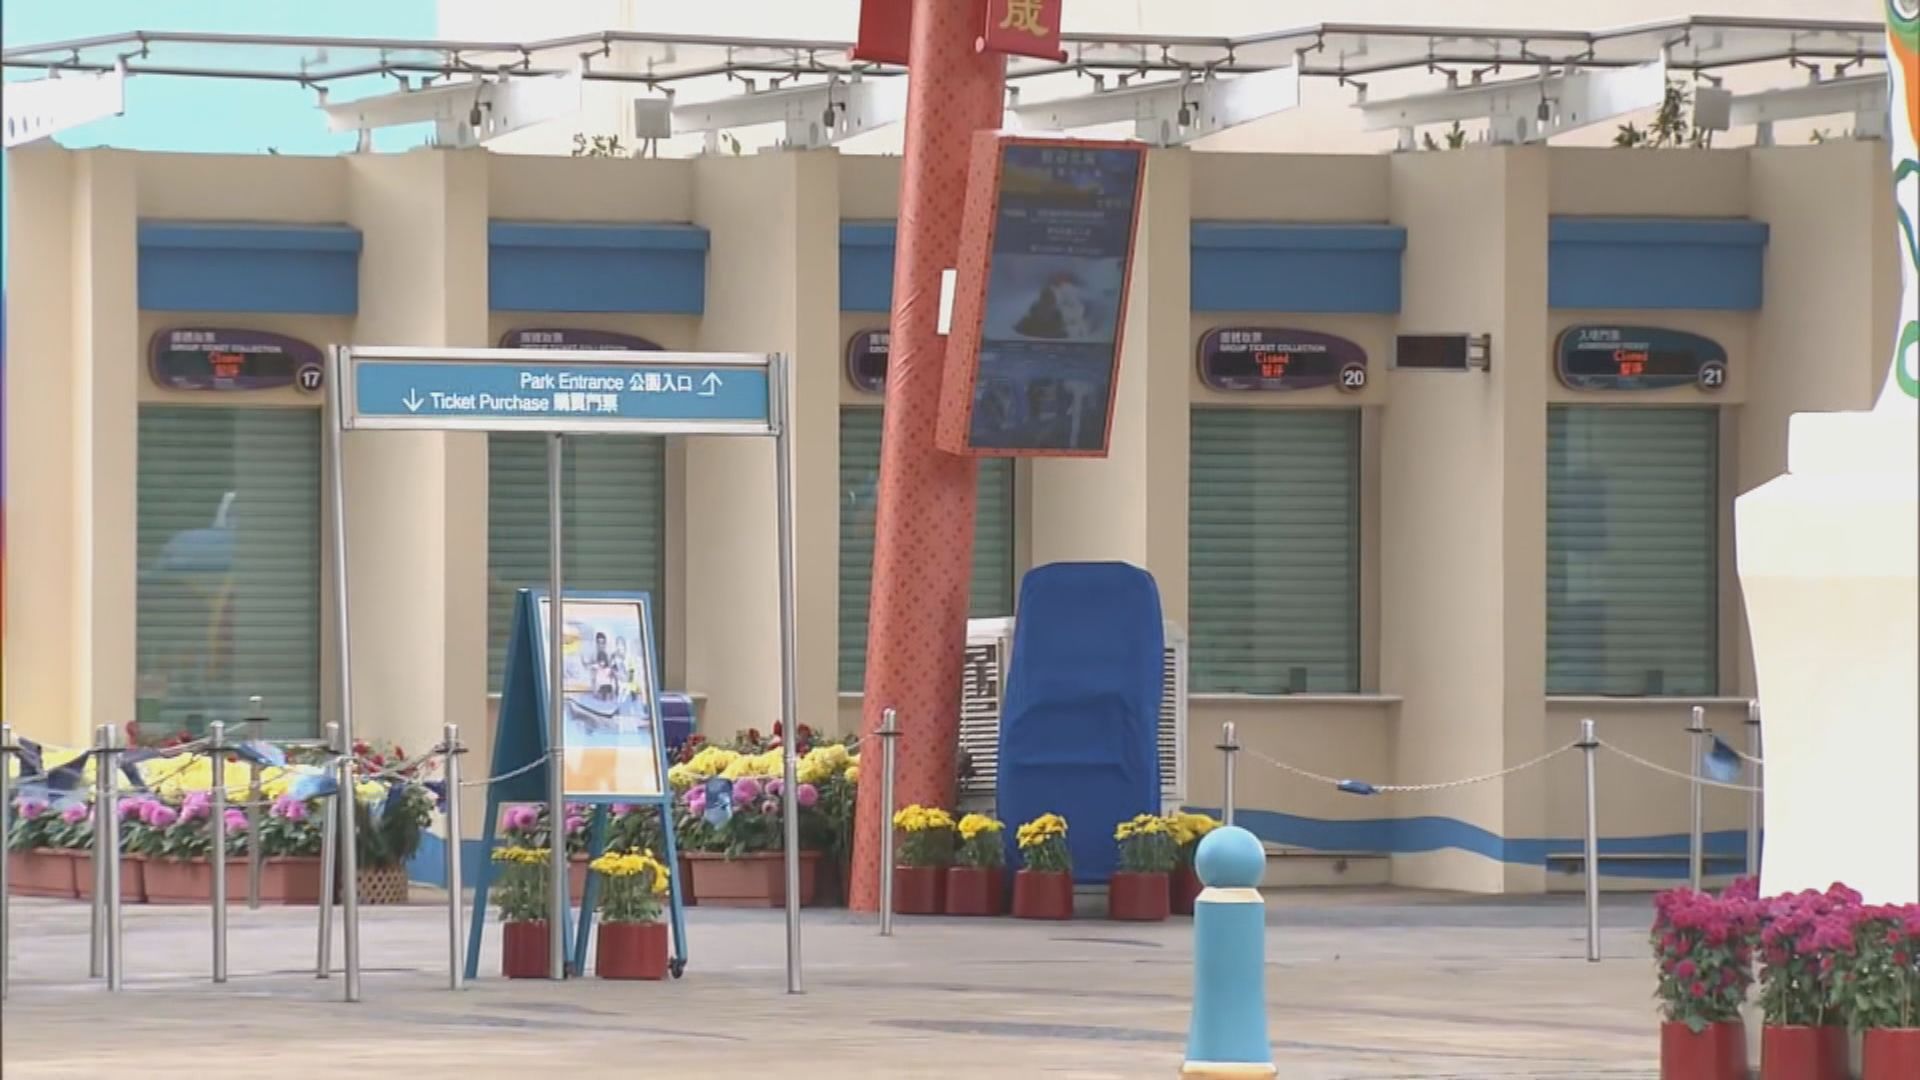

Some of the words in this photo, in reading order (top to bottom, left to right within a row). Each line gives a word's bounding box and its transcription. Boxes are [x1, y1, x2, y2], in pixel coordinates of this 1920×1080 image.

[1220, 344, 1249, 352] GROUP
[1250, 344, 1276, 352] TICKET
[1277, 344, 1326, 352] COLLECTION
[302, 371, 320, 387] 17
[520, 372, 555, 389] Park
[558, 372, 624, 391] Entrance
[629, 372, 692, 392] 公園入口
[1344, 369, 1365, 386] 20
[1703, 369, 1723, 384] 21
[430, 392, 475, 409] Ticket
[480, 394, 549, 411] Purchase
